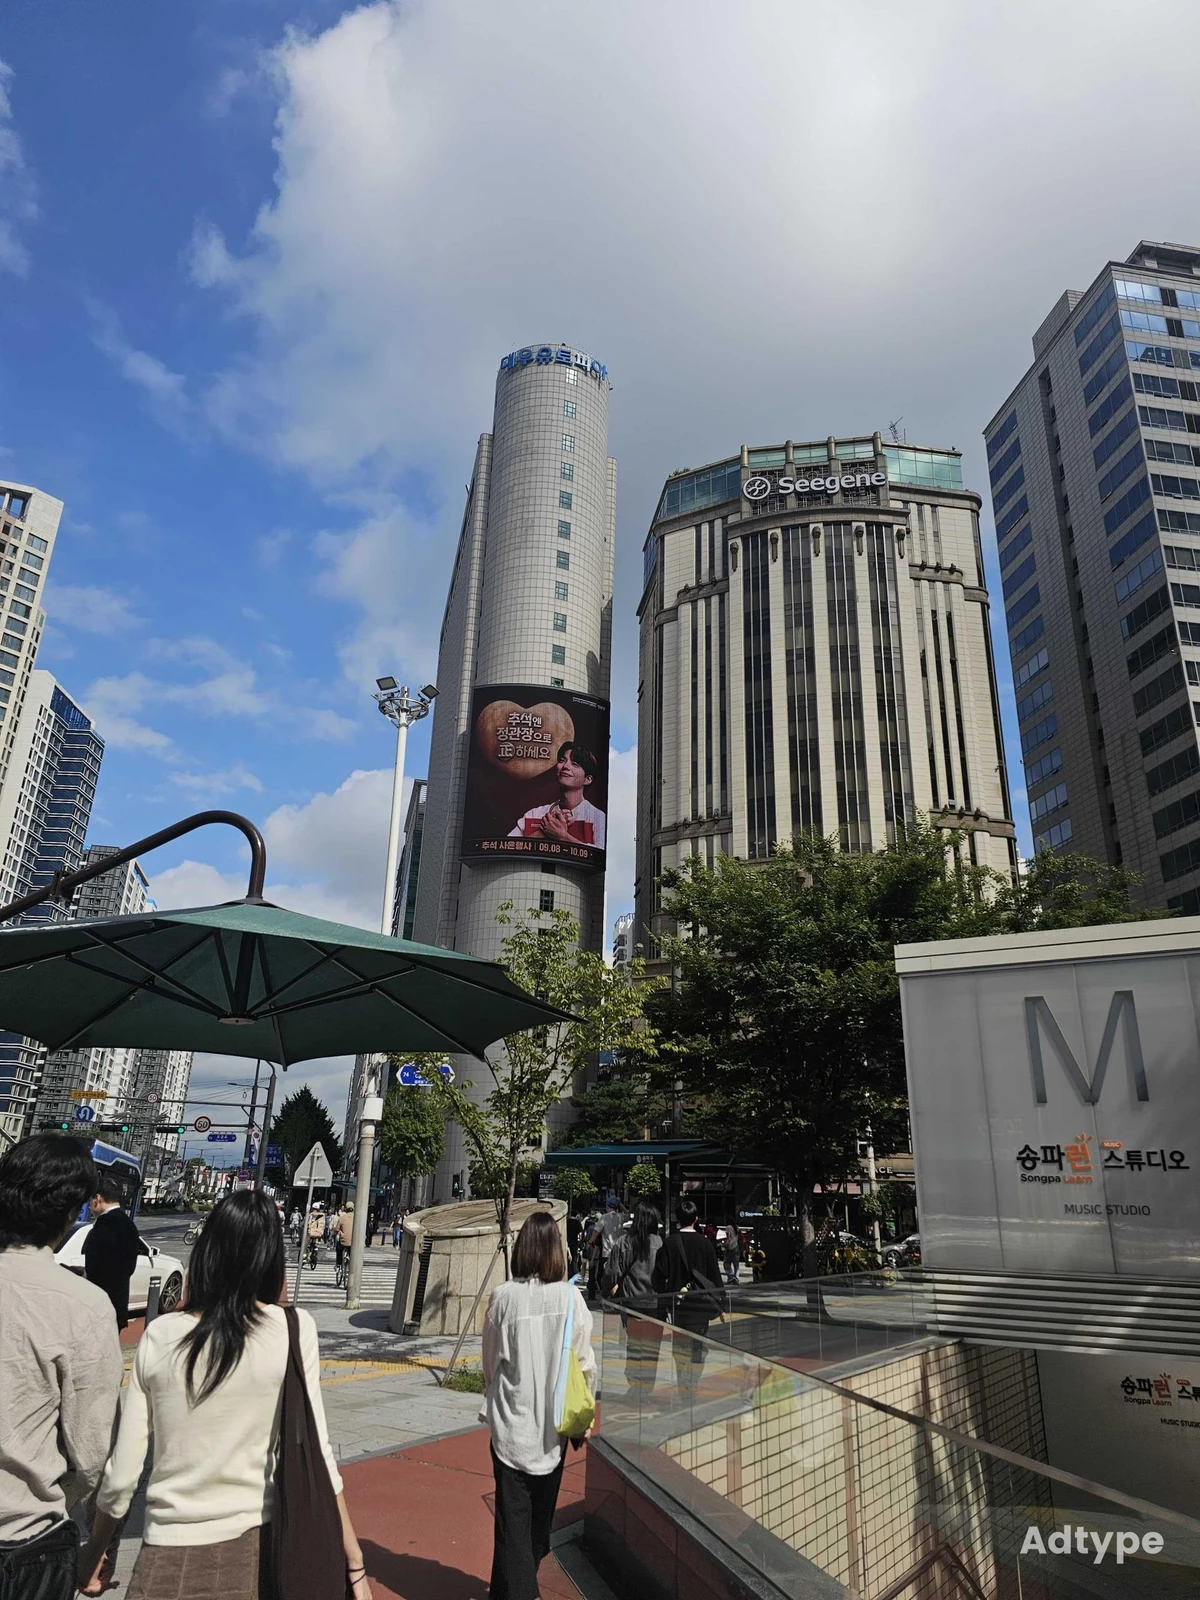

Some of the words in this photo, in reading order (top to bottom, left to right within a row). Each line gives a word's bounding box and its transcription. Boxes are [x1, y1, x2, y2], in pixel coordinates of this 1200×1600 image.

[500, 347, 608, 381] 대우유토피아
[778, 472, 886, 494] Seegene
[508, 712, 542, 728] 추석엔
[496, 727, 552, 744] 정관장으로
[481, 841, 498, 850] 추석
[499, 841, 532, 851] 사은행사
[539, 843, 561, 853] 09.08
[570, 847, 588, 858] 10.09
[1024, 990, 1149, 1104] M
[197, 1120, 208, 1129] 50
[1016, 1142, 1093, 1172] 송파런
[1103, 1149, 1191, 1172] 스튜디오
[1020, 1173, 1062, 1184] Songpa
[1063, 1174, 1094, 1185] Learn
[1064, 1203, 1103, 1216] MUSIC
[1105, 1204, 1151, 1216] STUDIO
[1120, 1376, 1172, 1398] 송파런
[1123, 1396, 1151, 1406] Songpa
[1152, 1399, 1172, 1407] Learn
[1160, 1418, 1180, 1426] MUSIC
